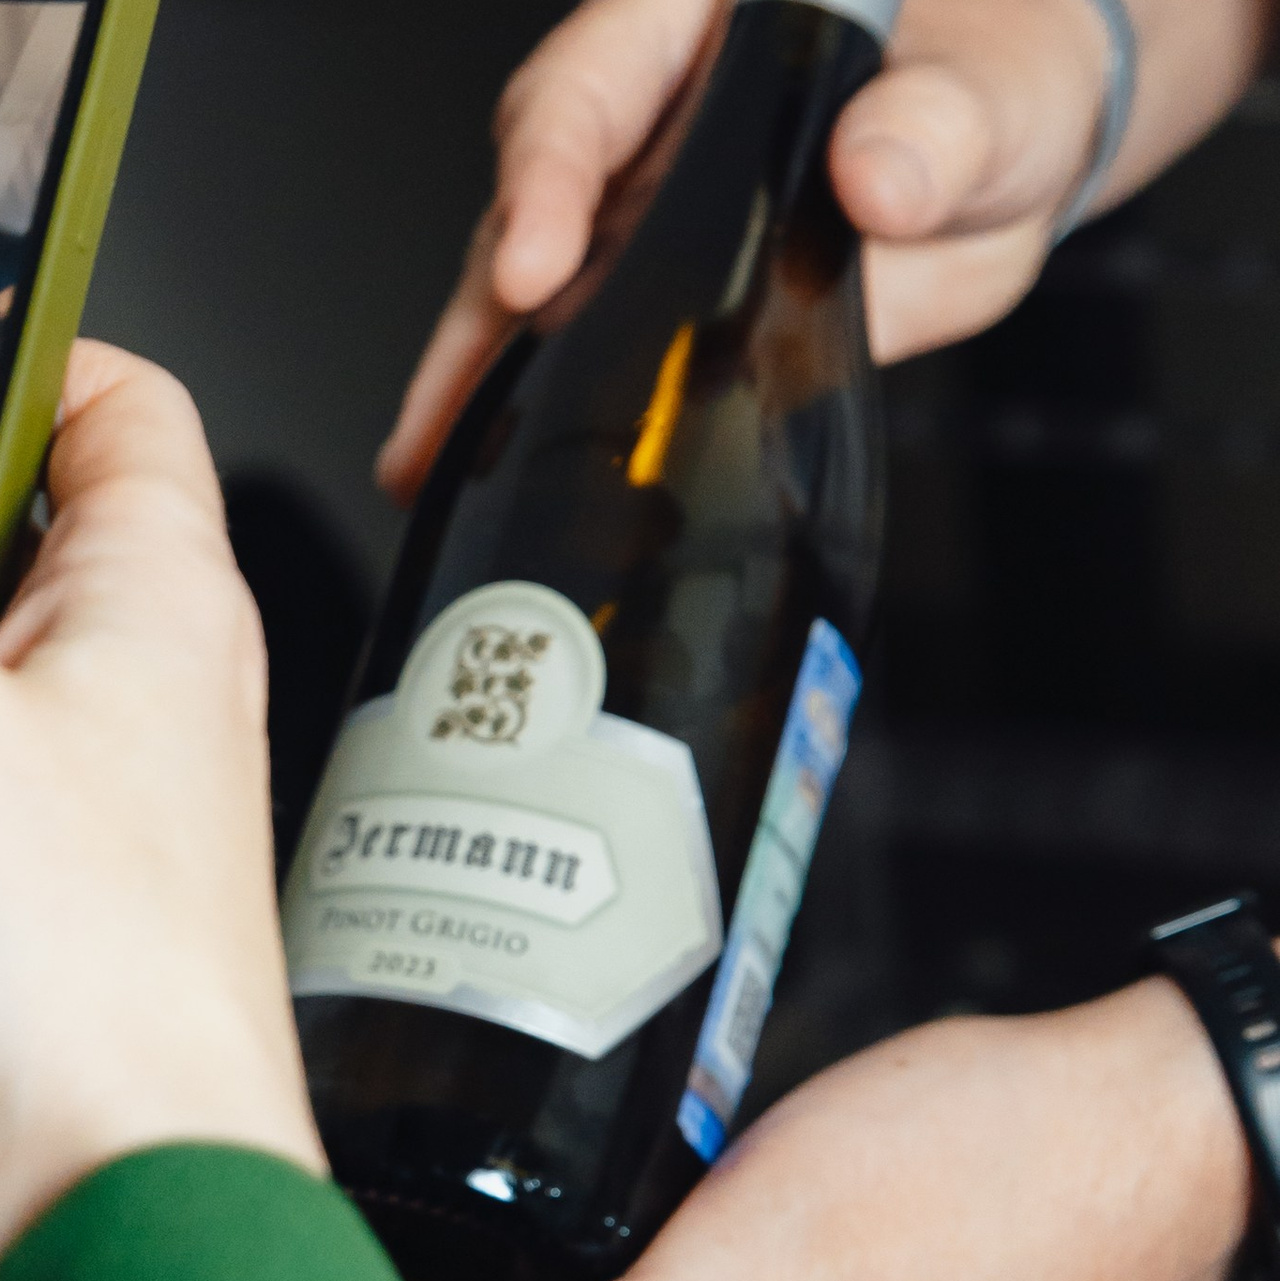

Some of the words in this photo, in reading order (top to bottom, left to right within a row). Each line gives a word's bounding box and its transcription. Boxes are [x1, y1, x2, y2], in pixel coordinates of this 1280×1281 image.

[322, 811, 582, 892] Jermann
[320, 906, 404, 933] PINOT
[409, 908, 531, 958] GRIGIO
